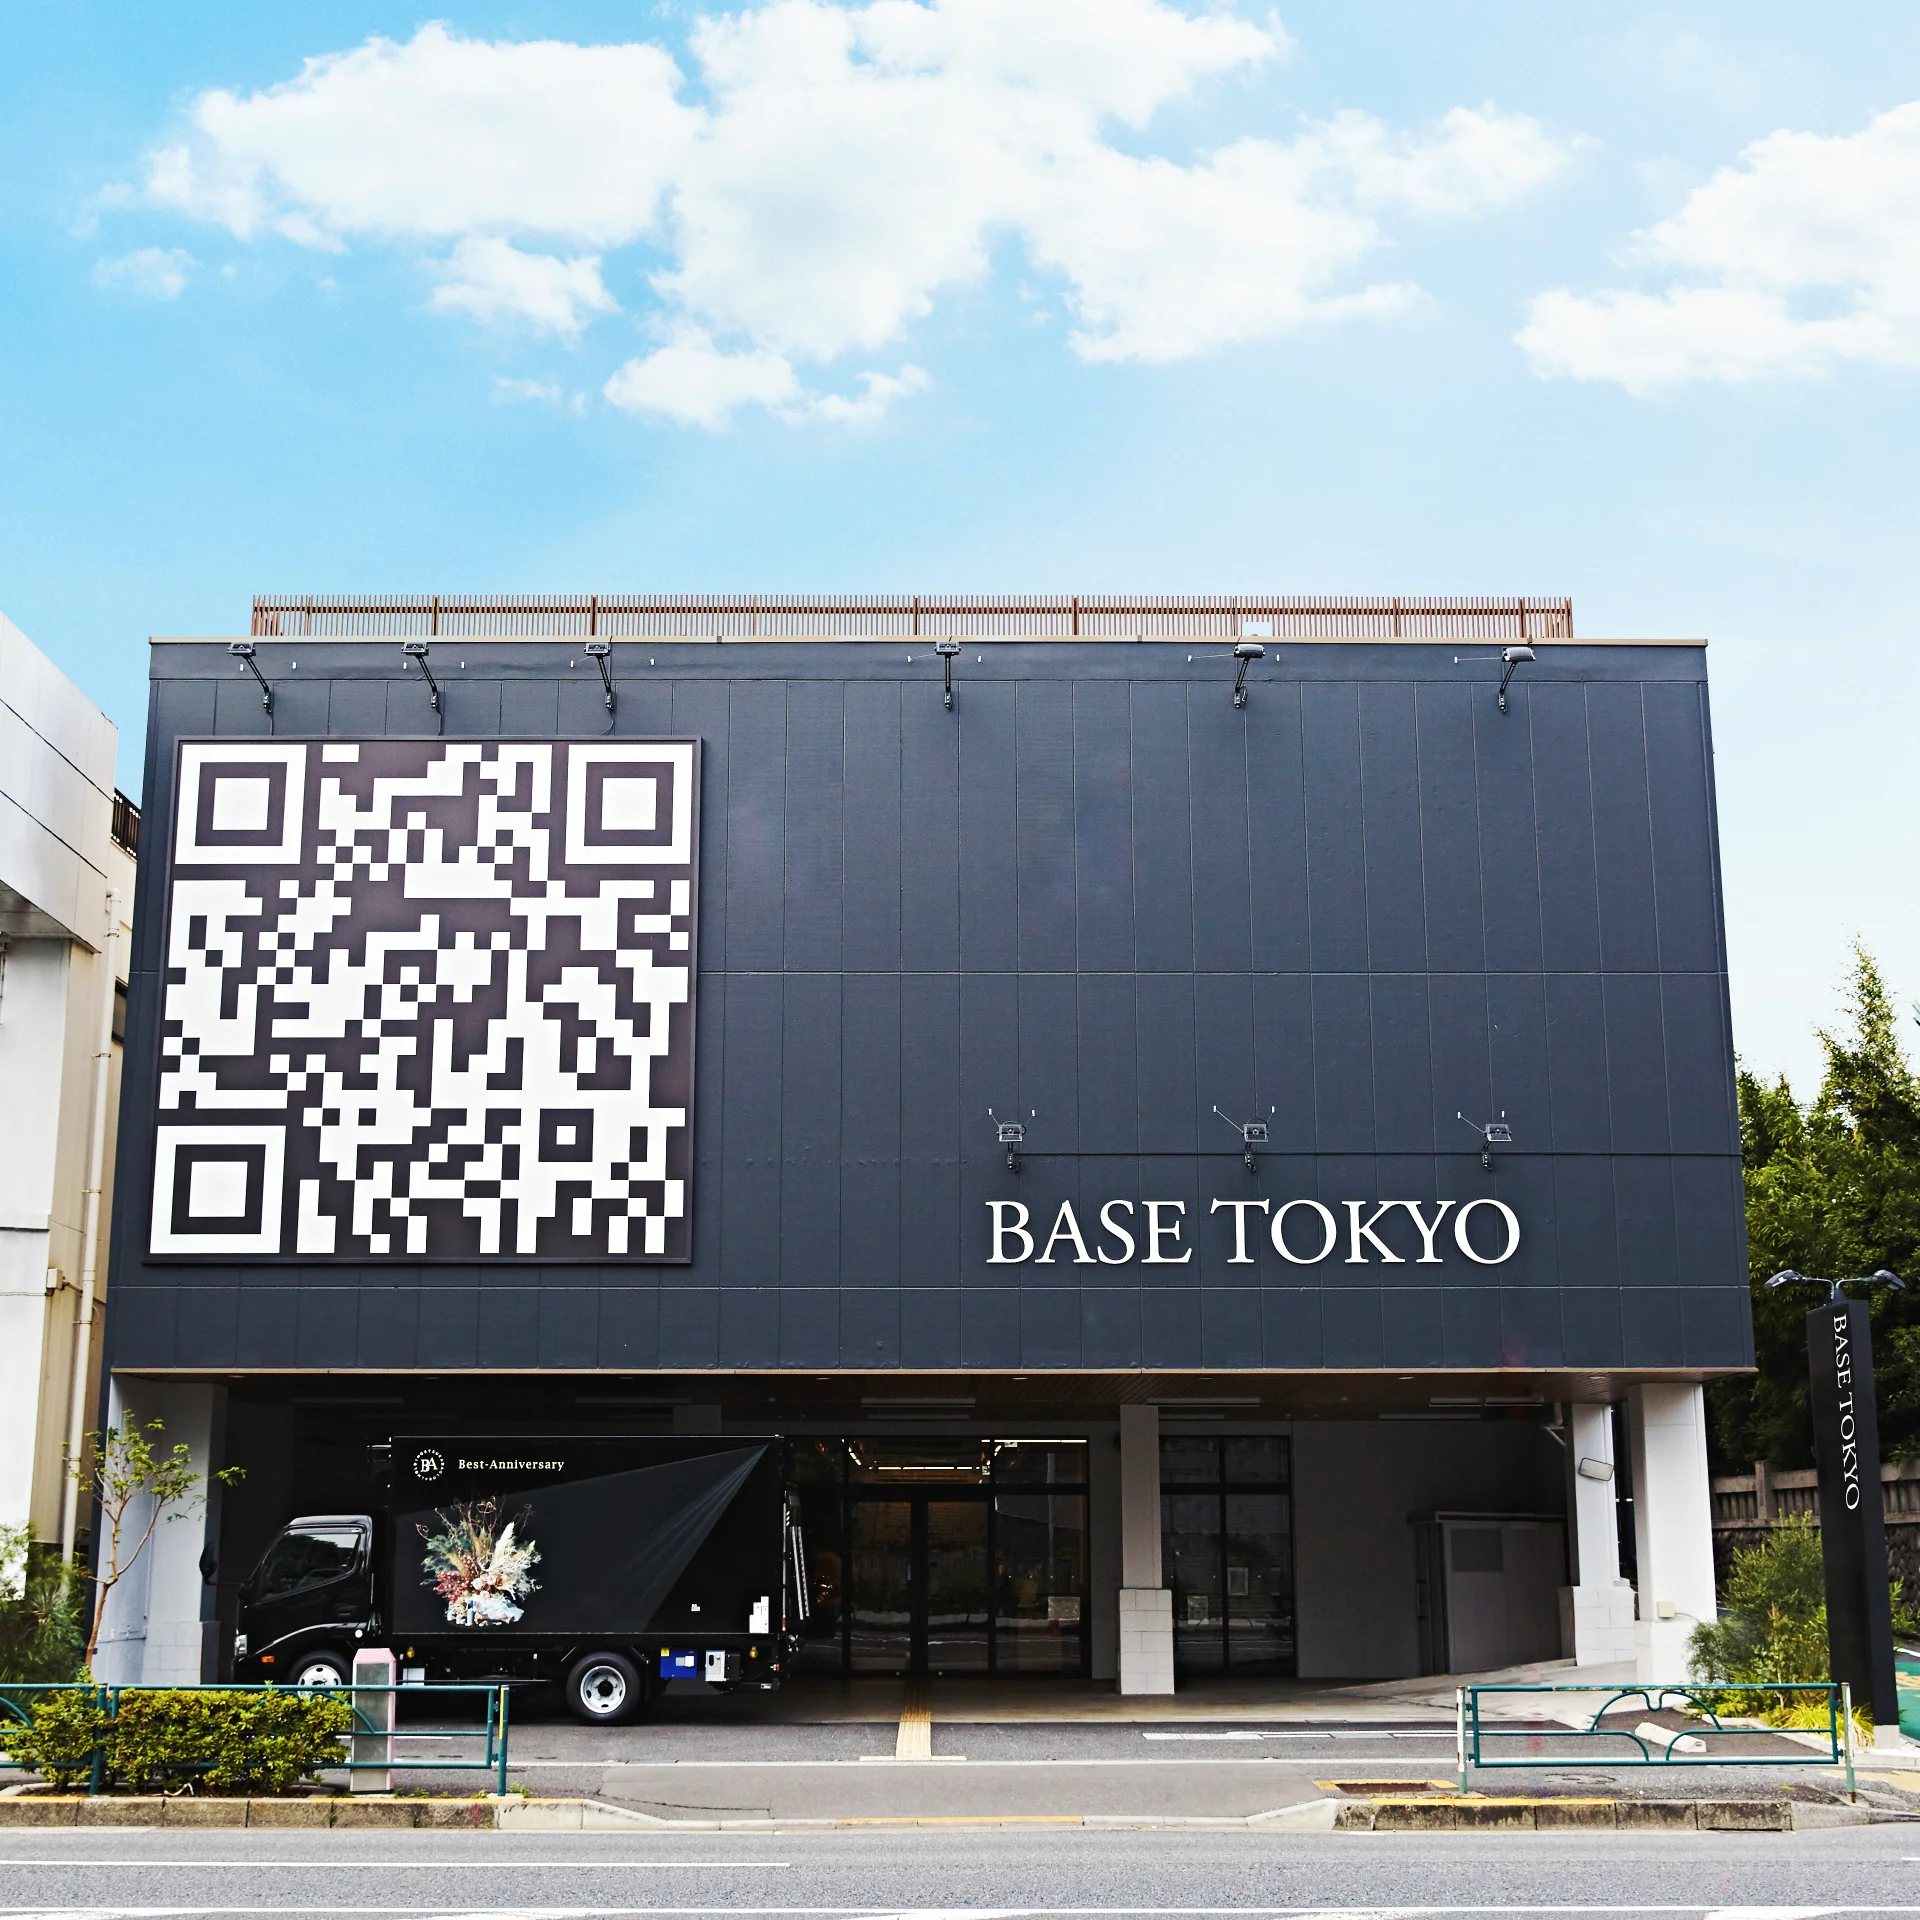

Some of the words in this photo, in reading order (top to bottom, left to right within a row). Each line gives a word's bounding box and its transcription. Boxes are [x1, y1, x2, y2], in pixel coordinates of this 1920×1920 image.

[985, 1199, 1193, 1265] BASE
[1210, 1198, 1521, 1265] TOKYO
[1833, 1313, 1852, 1389] BASE
[458, 1459, 565, 1472] Best-Anniversary
[1839, 1392, 1860, 1510] TOKYO
